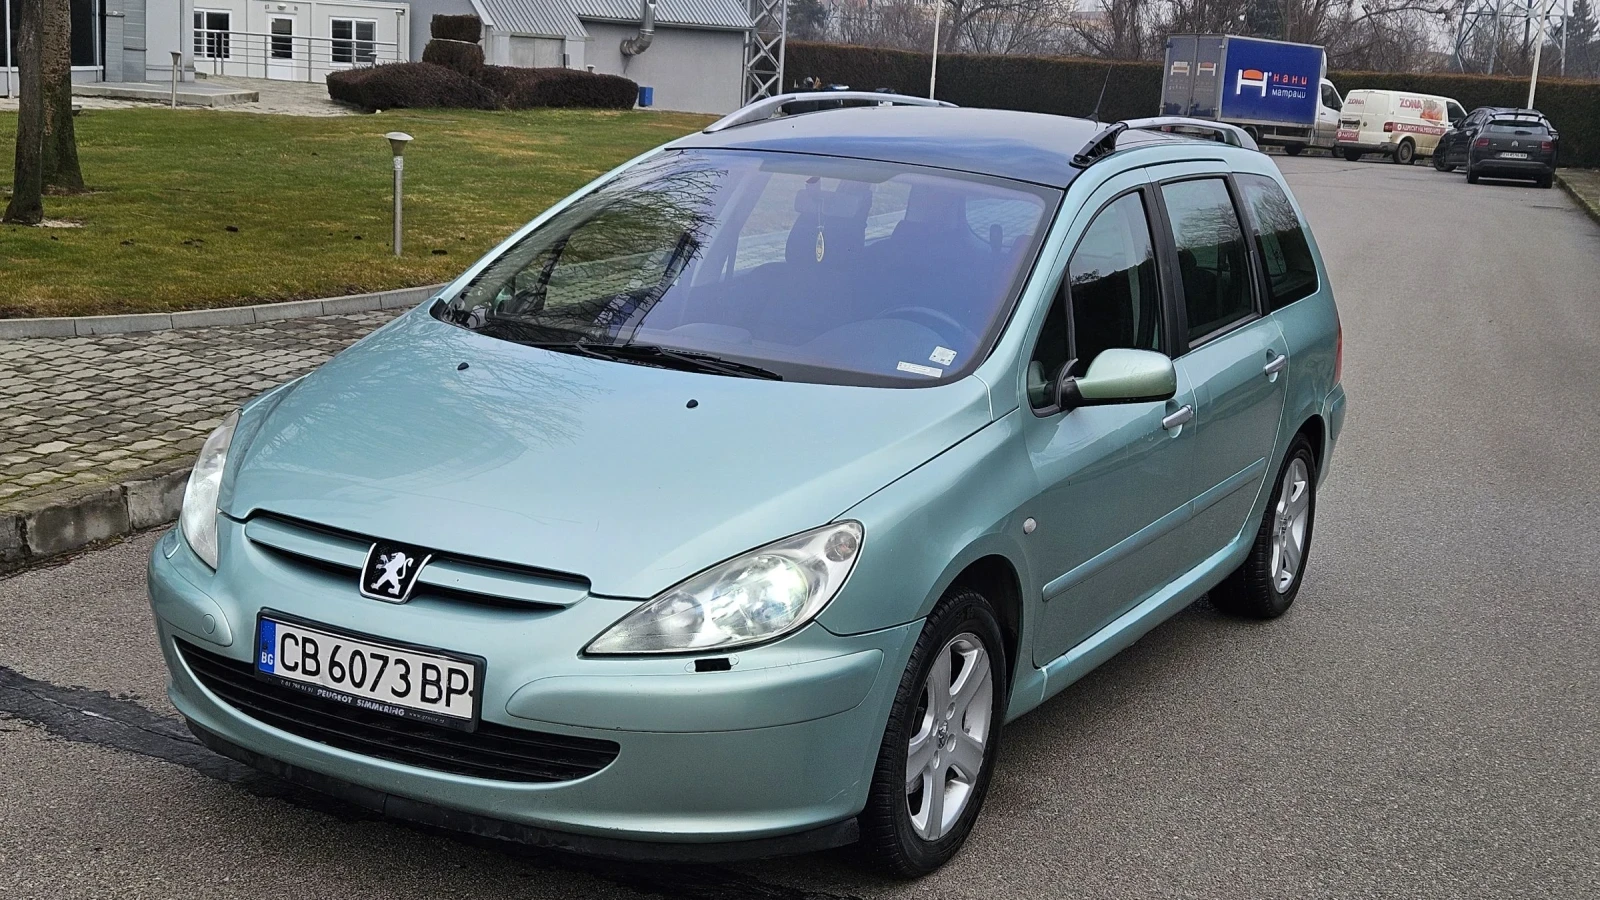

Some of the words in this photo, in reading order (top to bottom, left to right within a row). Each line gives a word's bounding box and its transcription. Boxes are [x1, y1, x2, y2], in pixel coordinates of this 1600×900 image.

[1273, 73, 1308, 85] нани
[1271, 88, 1307, 99] матраци
[1399, 97, 1423, 110] ZONA
[261, 651, 274, 666] BG
[280, 632, 321, 677] CB
[328, 644, 411, 699] 6073
[420, 662, 470, 708] BP
[317, 688, 353, 704] PEUGEOT
[356, 698, 405, 717] SIMMERING
